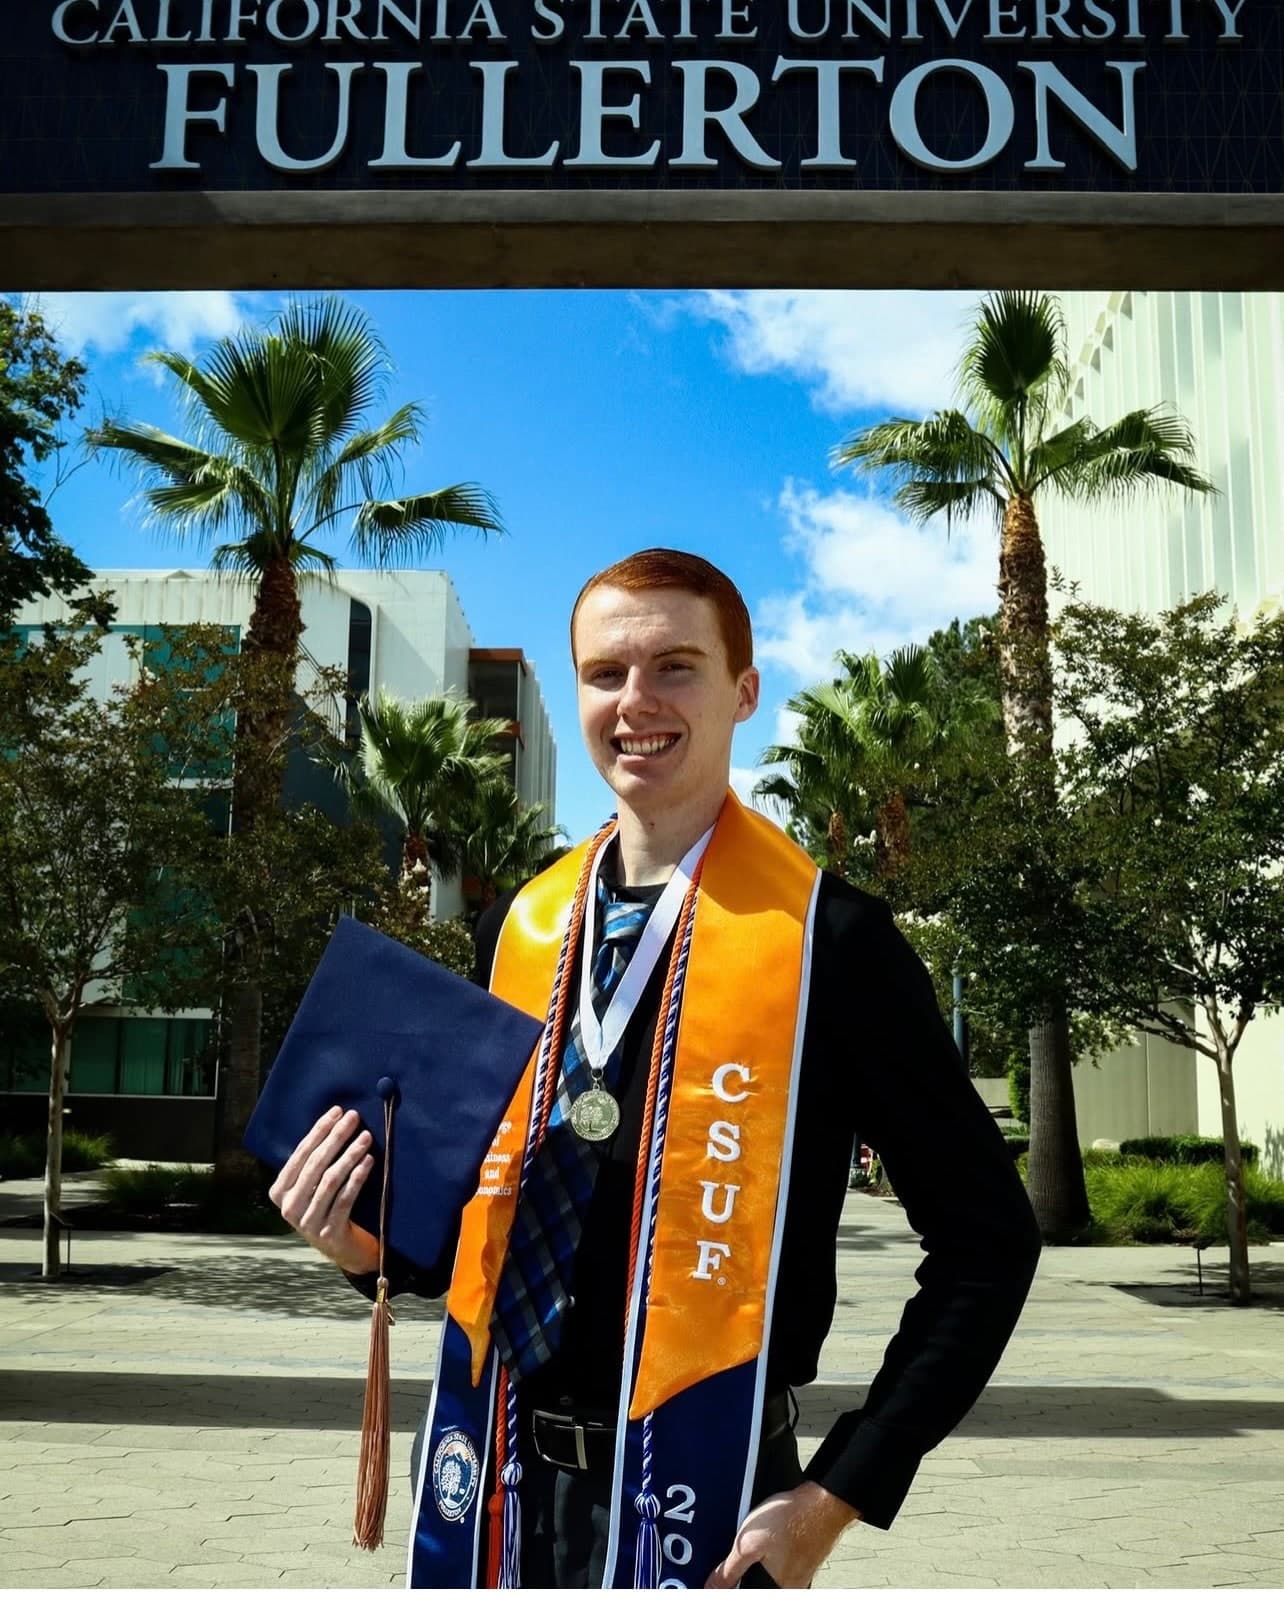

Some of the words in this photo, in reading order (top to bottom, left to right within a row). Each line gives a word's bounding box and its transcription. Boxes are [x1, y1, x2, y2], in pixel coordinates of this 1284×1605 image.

[52, 0, 508, 44] CALIFORNIA
[531, 0, 759, 44] STATE
[787, 0, 1246, 42] UNIVERSITY
[148, 55, 1148, 174] FULLERTON
